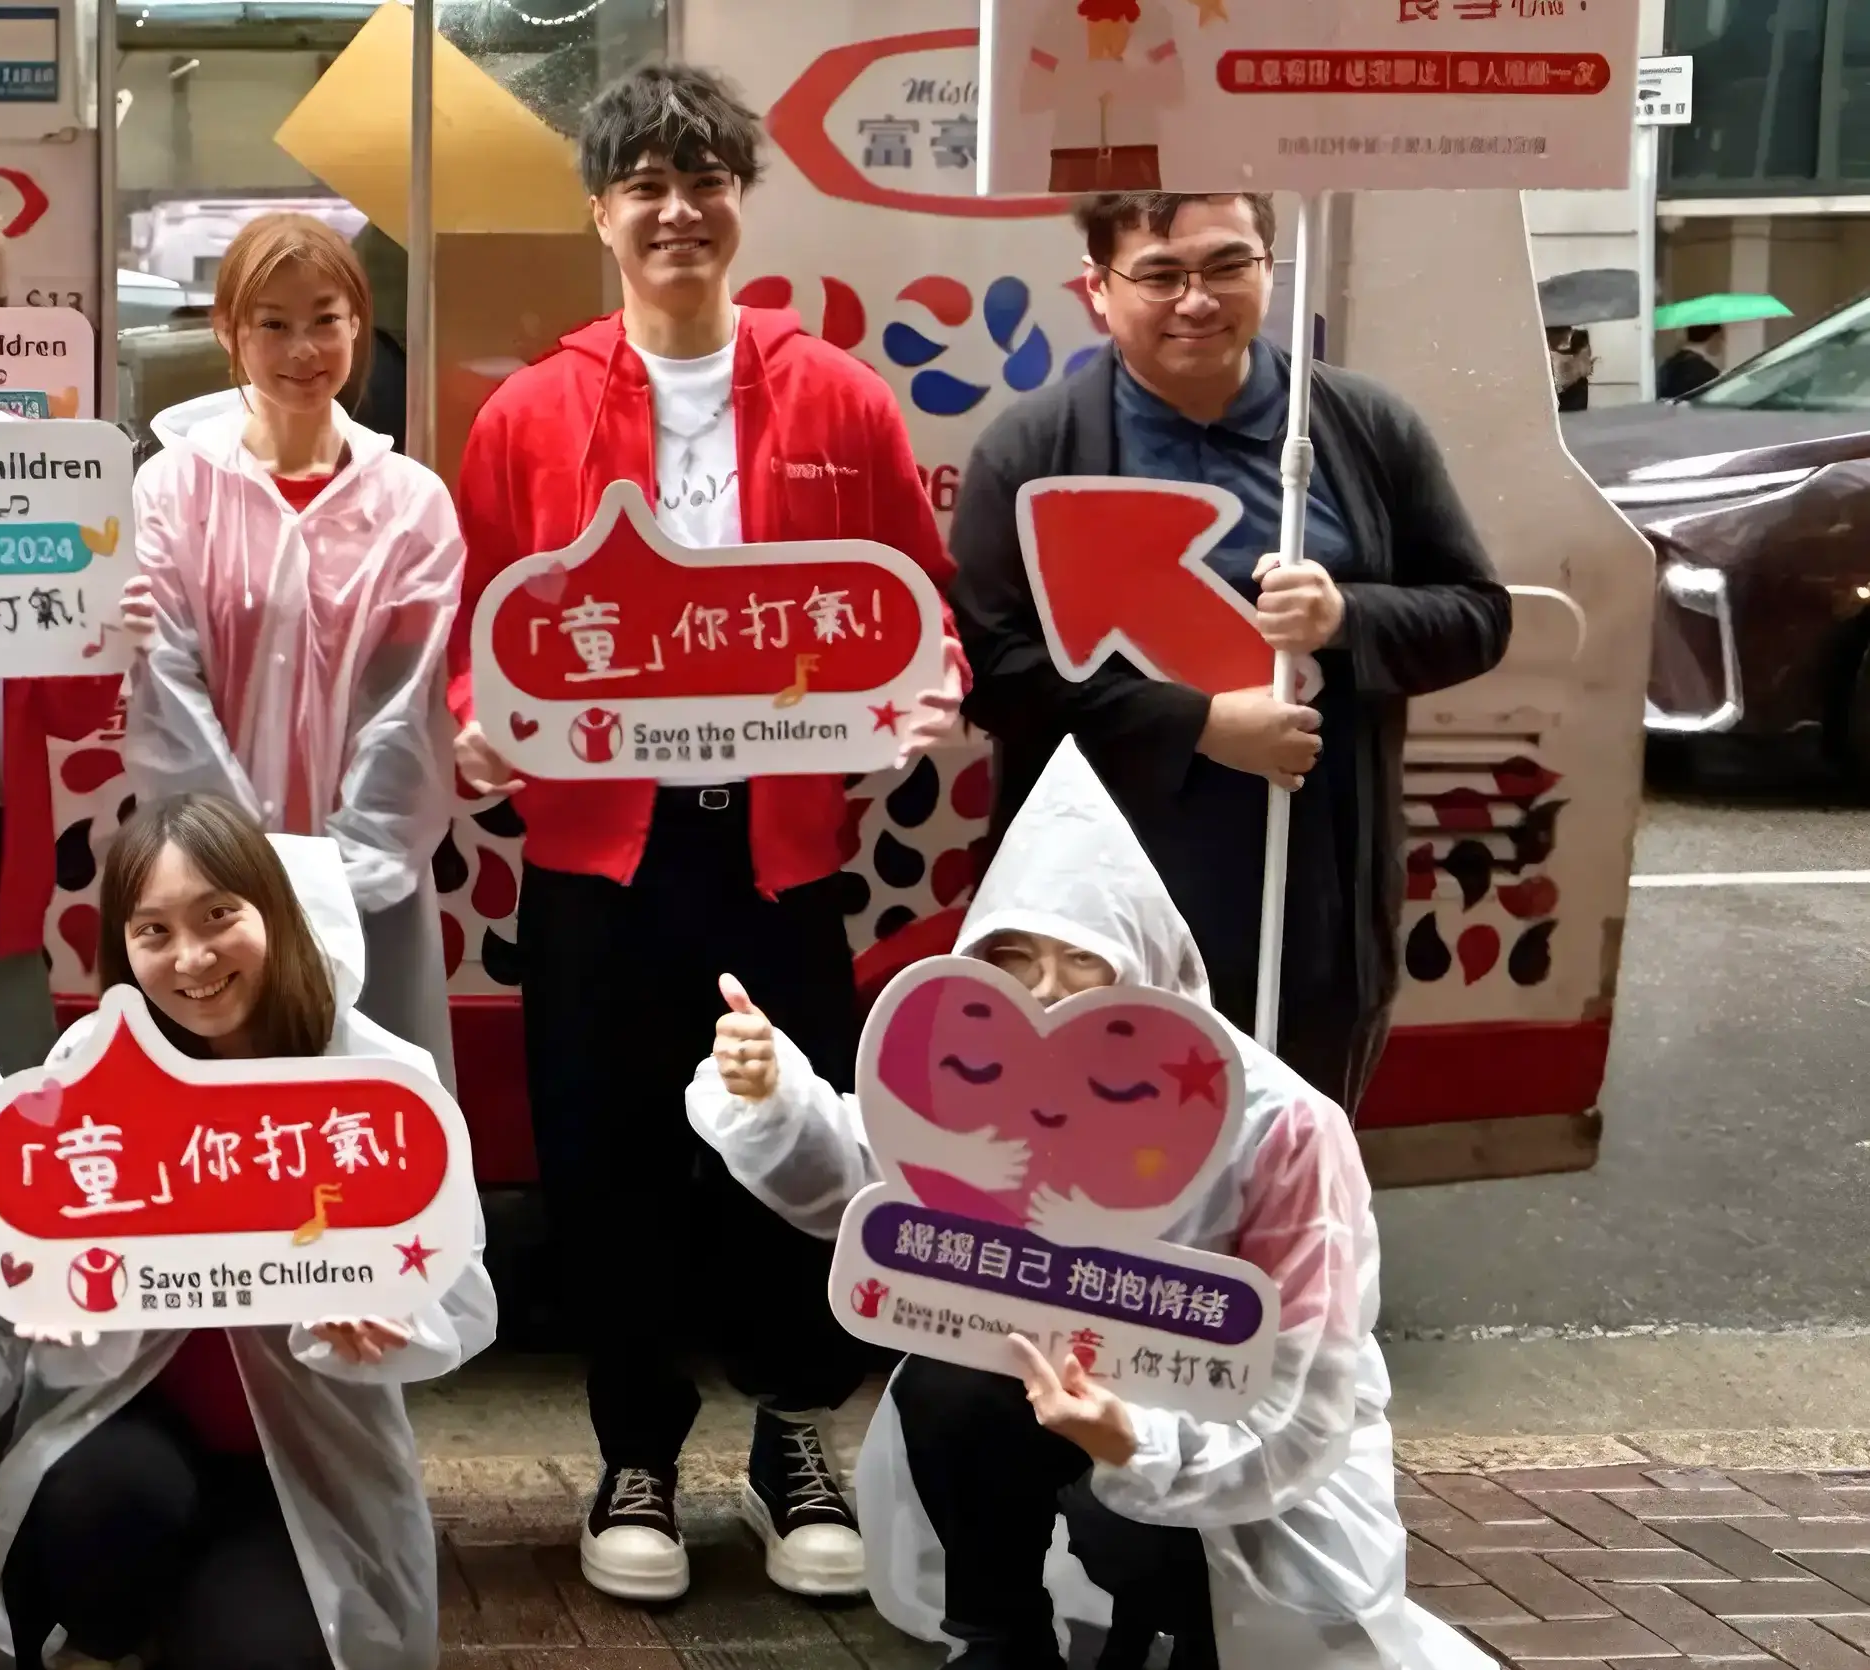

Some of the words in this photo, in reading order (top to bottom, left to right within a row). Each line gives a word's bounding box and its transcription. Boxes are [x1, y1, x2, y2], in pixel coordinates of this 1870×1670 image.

[633, 723, 690, 745] Save
[697, 721, 736, 743] the
[742, 719, 848, 741] Children
[139, 1265, 201, 1290] Save
[209, 1262, 252, 1288] the
[259, 1259, 374, 1285] Children
